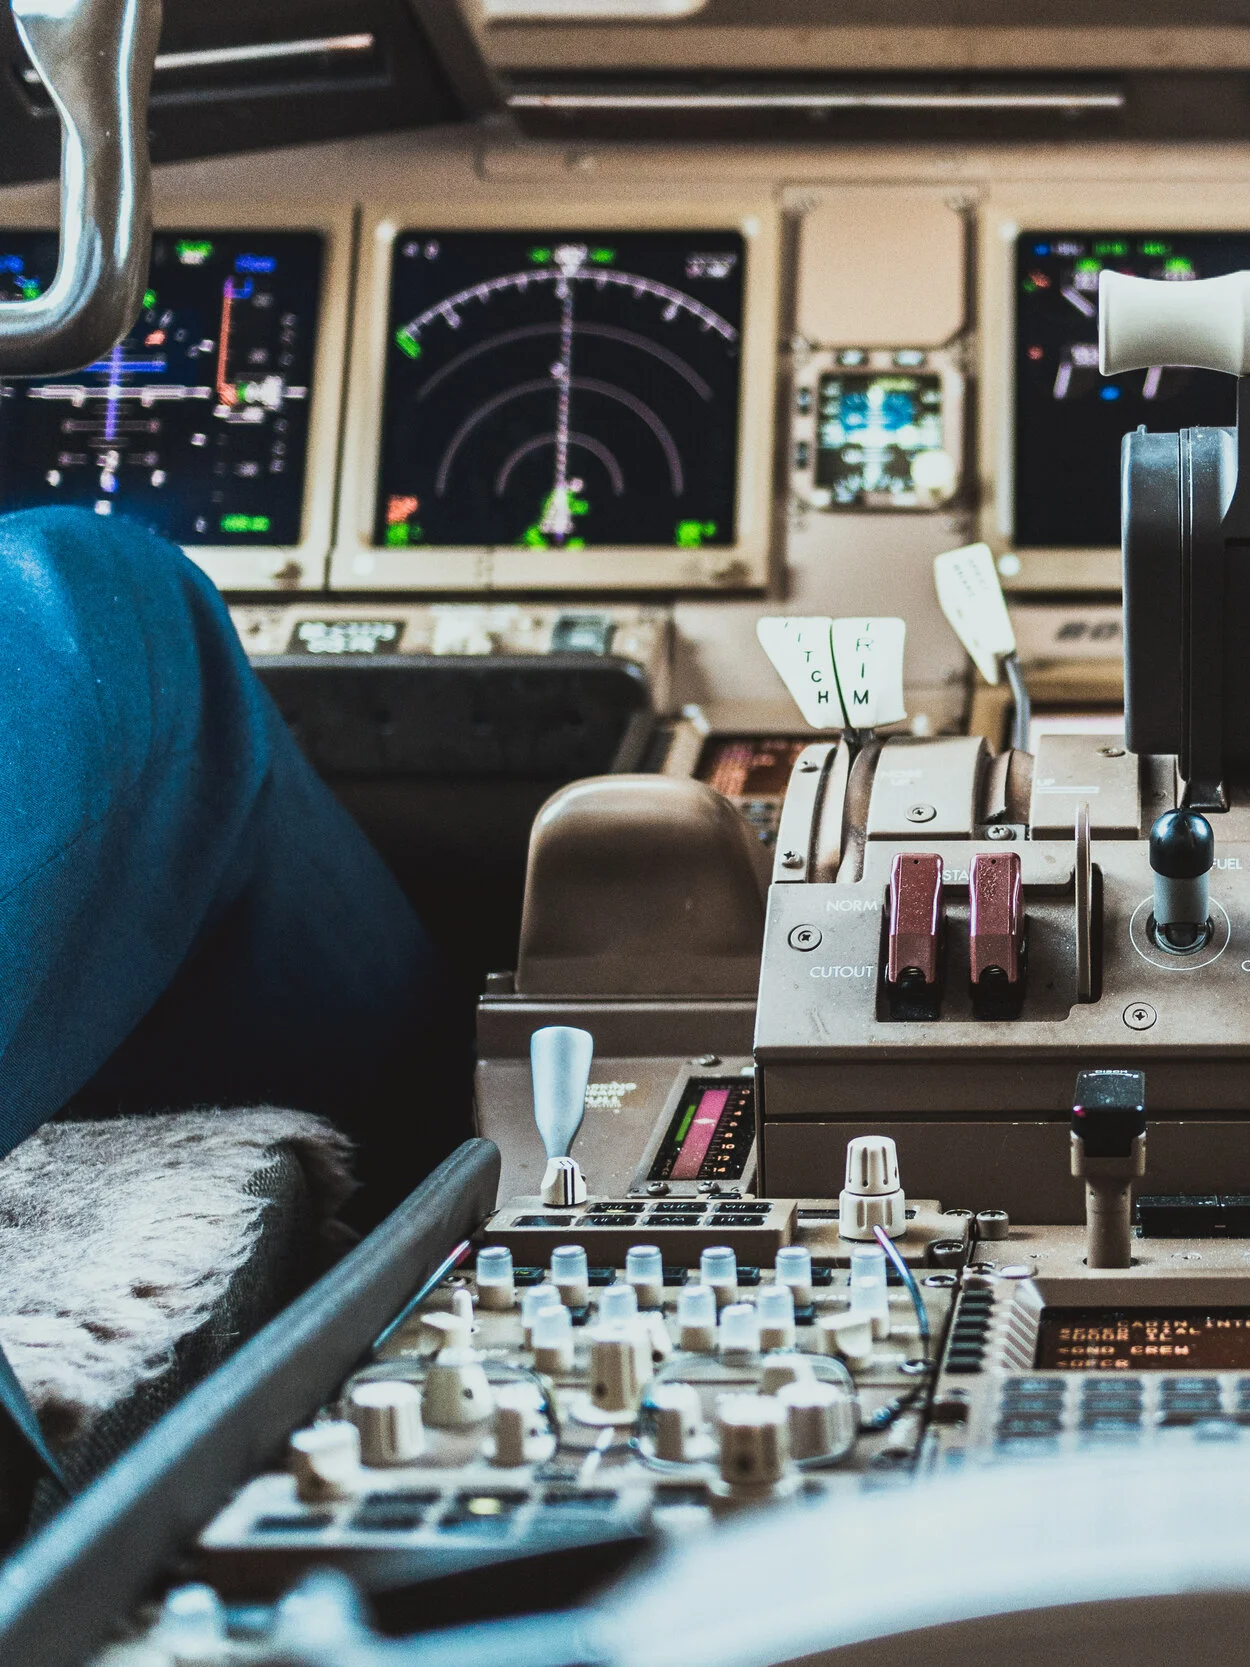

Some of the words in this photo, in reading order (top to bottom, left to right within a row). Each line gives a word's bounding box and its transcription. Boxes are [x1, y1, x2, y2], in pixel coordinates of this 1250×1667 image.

[943, 869, 969, 881] STA
[826, 900, 878, 911] NORM
[810, 965, 874, 978] CUTOUT
[1130, 1345, 1190, 1355] CREW
